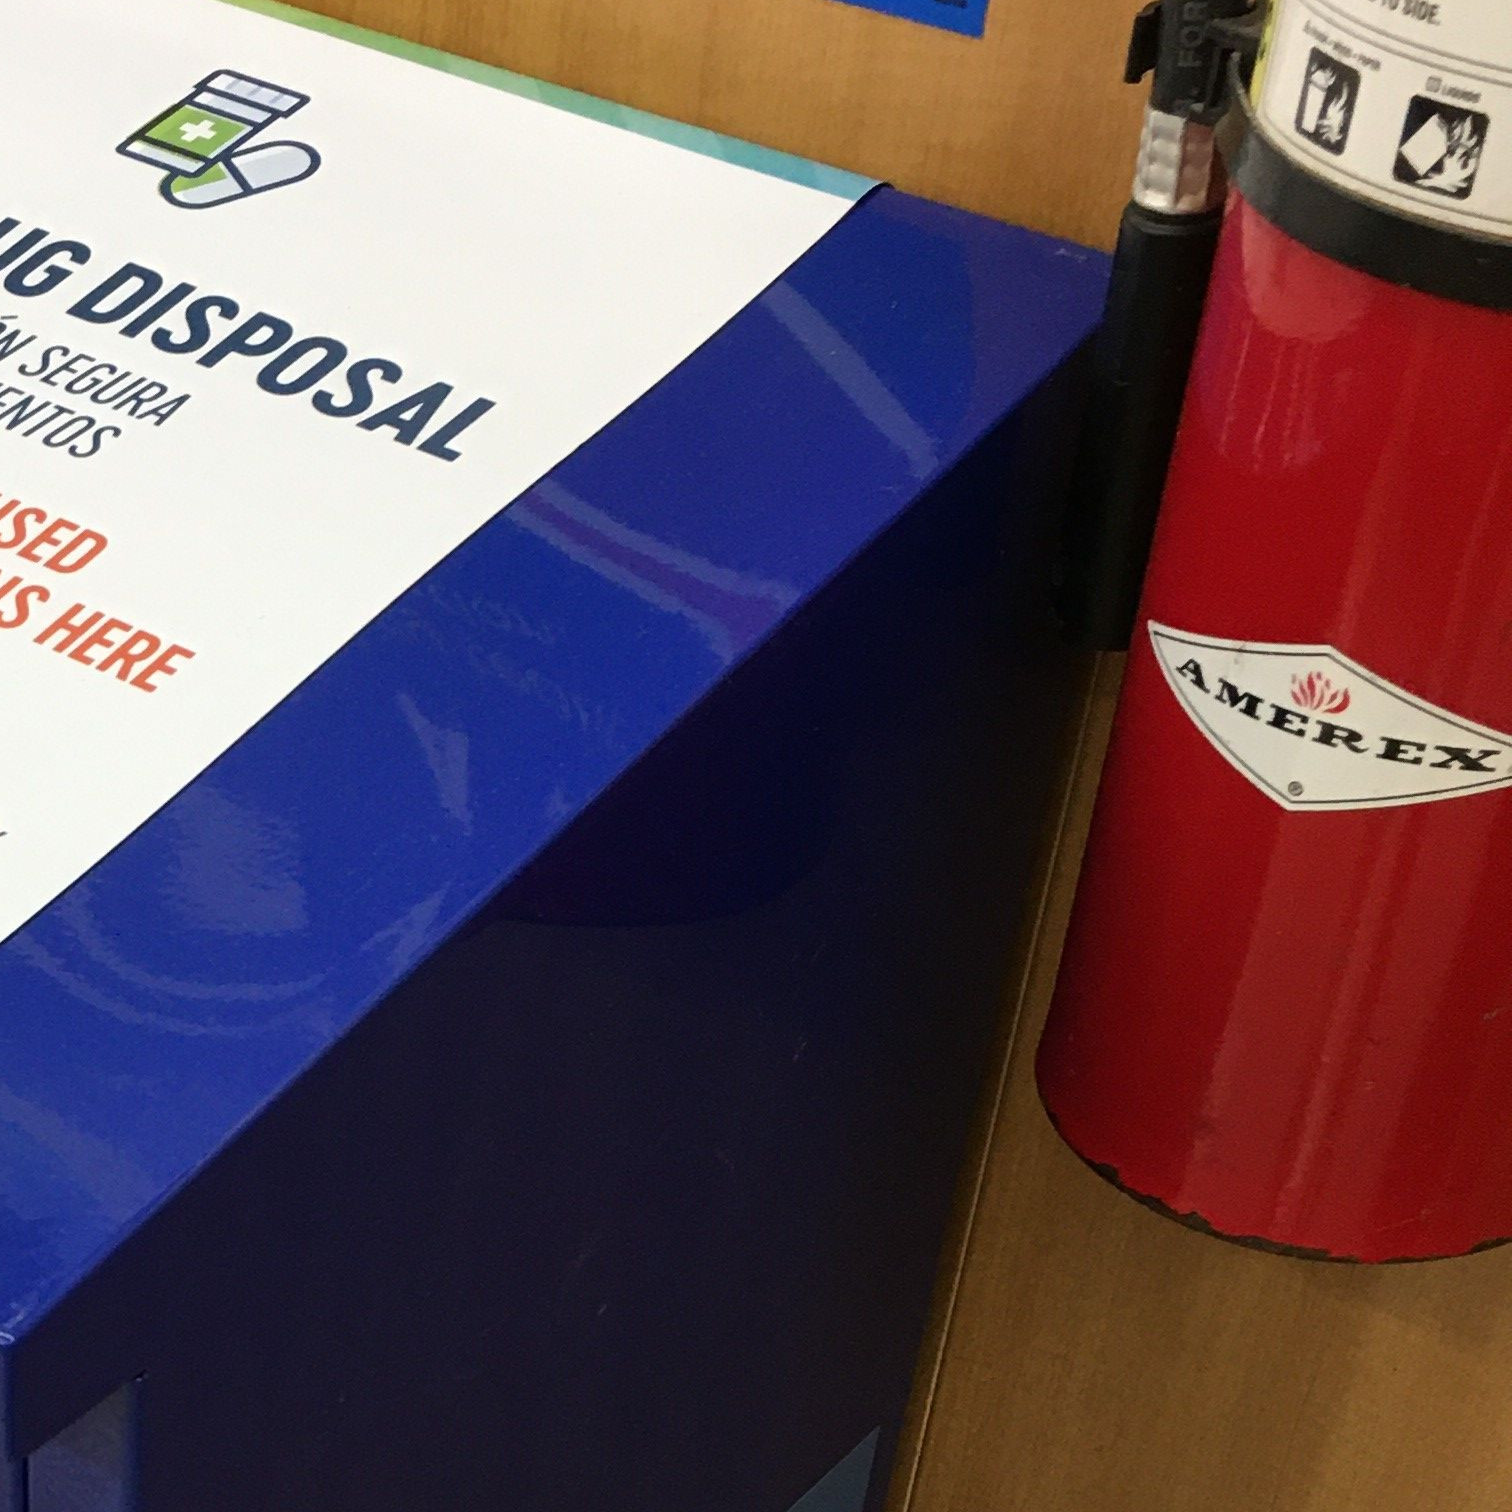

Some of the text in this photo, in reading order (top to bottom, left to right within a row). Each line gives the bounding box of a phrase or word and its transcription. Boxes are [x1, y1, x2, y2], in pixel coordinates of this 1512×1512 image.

[17, 345, 191, 427] SEGURA
[66, 262, 495, 462] DISPOSAL
[33, 603, 196, 694] HERE
[1175, 657, 1501, 772] AMEREX
